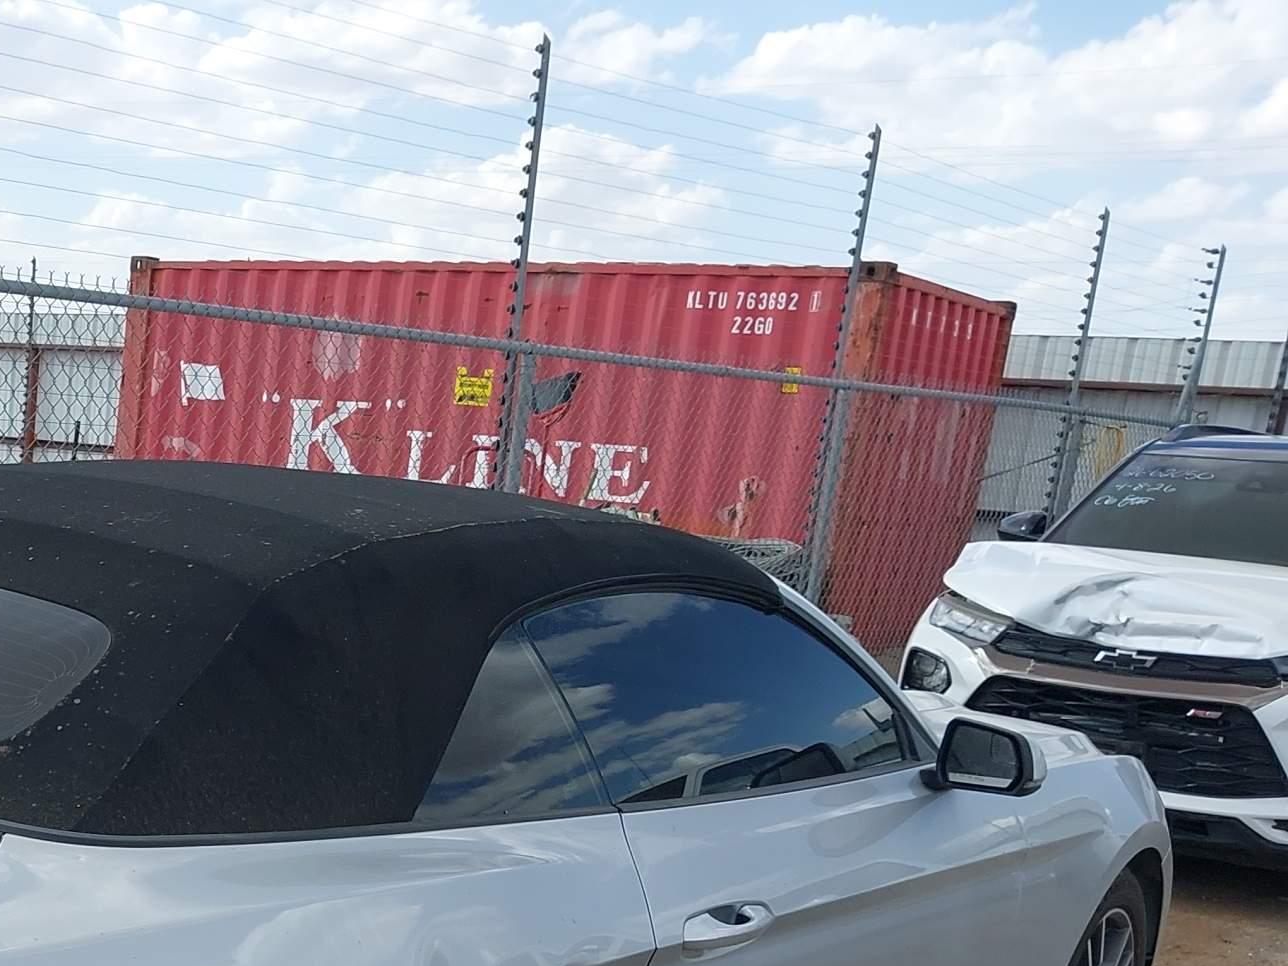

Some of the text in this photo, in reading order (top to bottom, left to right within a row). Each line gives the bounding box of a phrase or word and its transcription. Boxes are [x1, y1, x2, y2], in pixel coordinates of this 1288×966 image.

[686, 290, 728, 309] KLTU
[735, 291, 799, 311] 763692
[406, 430, 649, 504] LINE
